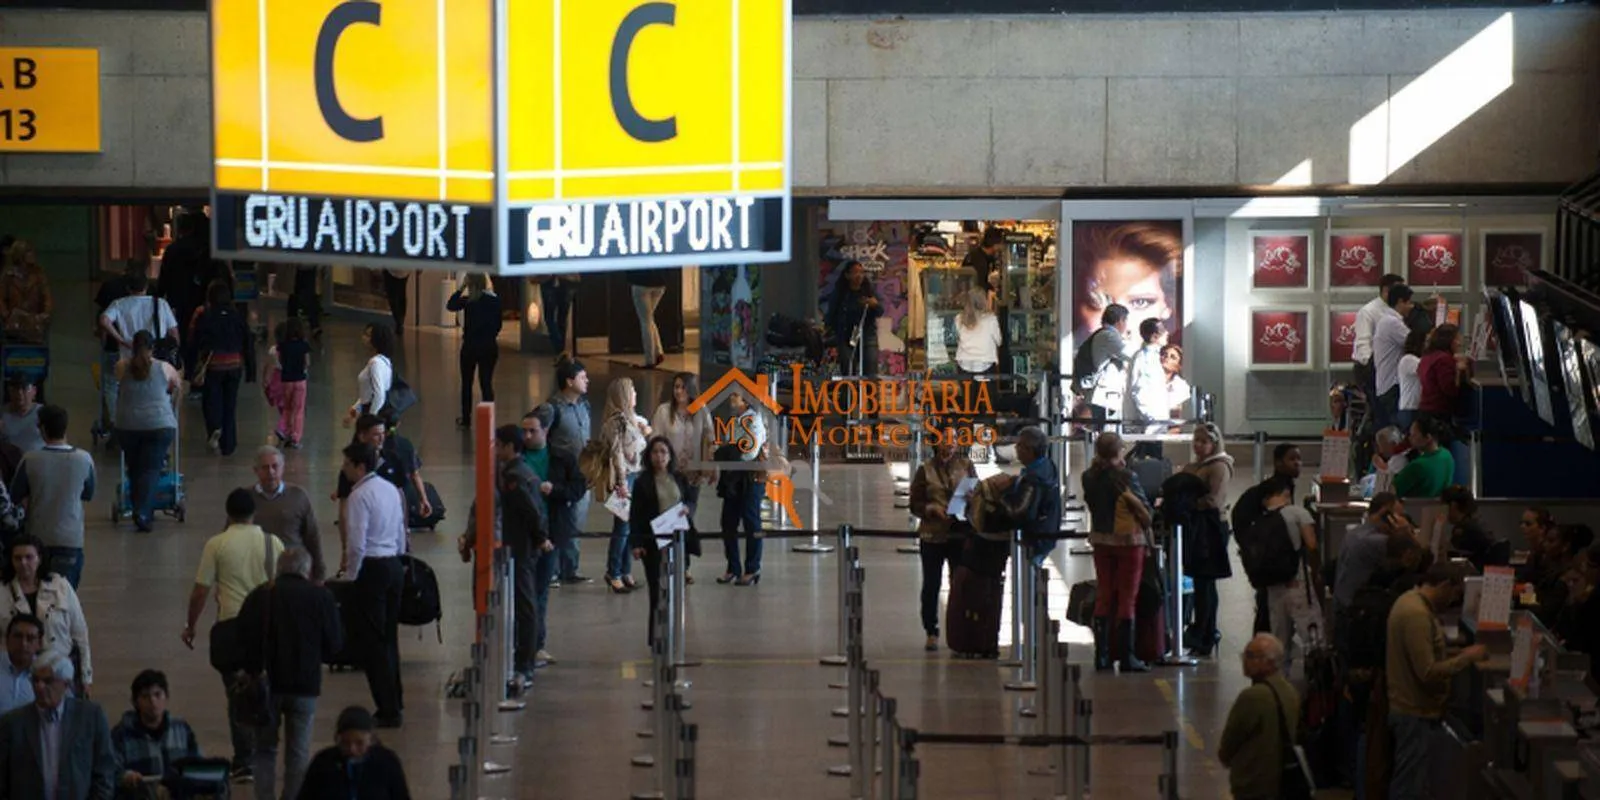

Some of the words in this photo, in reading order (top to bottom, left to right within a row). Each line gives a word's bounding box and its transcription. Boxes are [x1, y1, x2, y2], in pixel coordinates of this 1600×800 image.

[14, 57, 37, 90] B
[314, 0, 384, 143] C
[609, 2, 678, 143] C
[0, 108, 37, 141] 13
[245, 193, 309, 248] GRU
[313, 196, 470, 259] AIRPORT
[527, 203, 595, 259] GRU
[599, 197, 755, 256] AIRPORT
